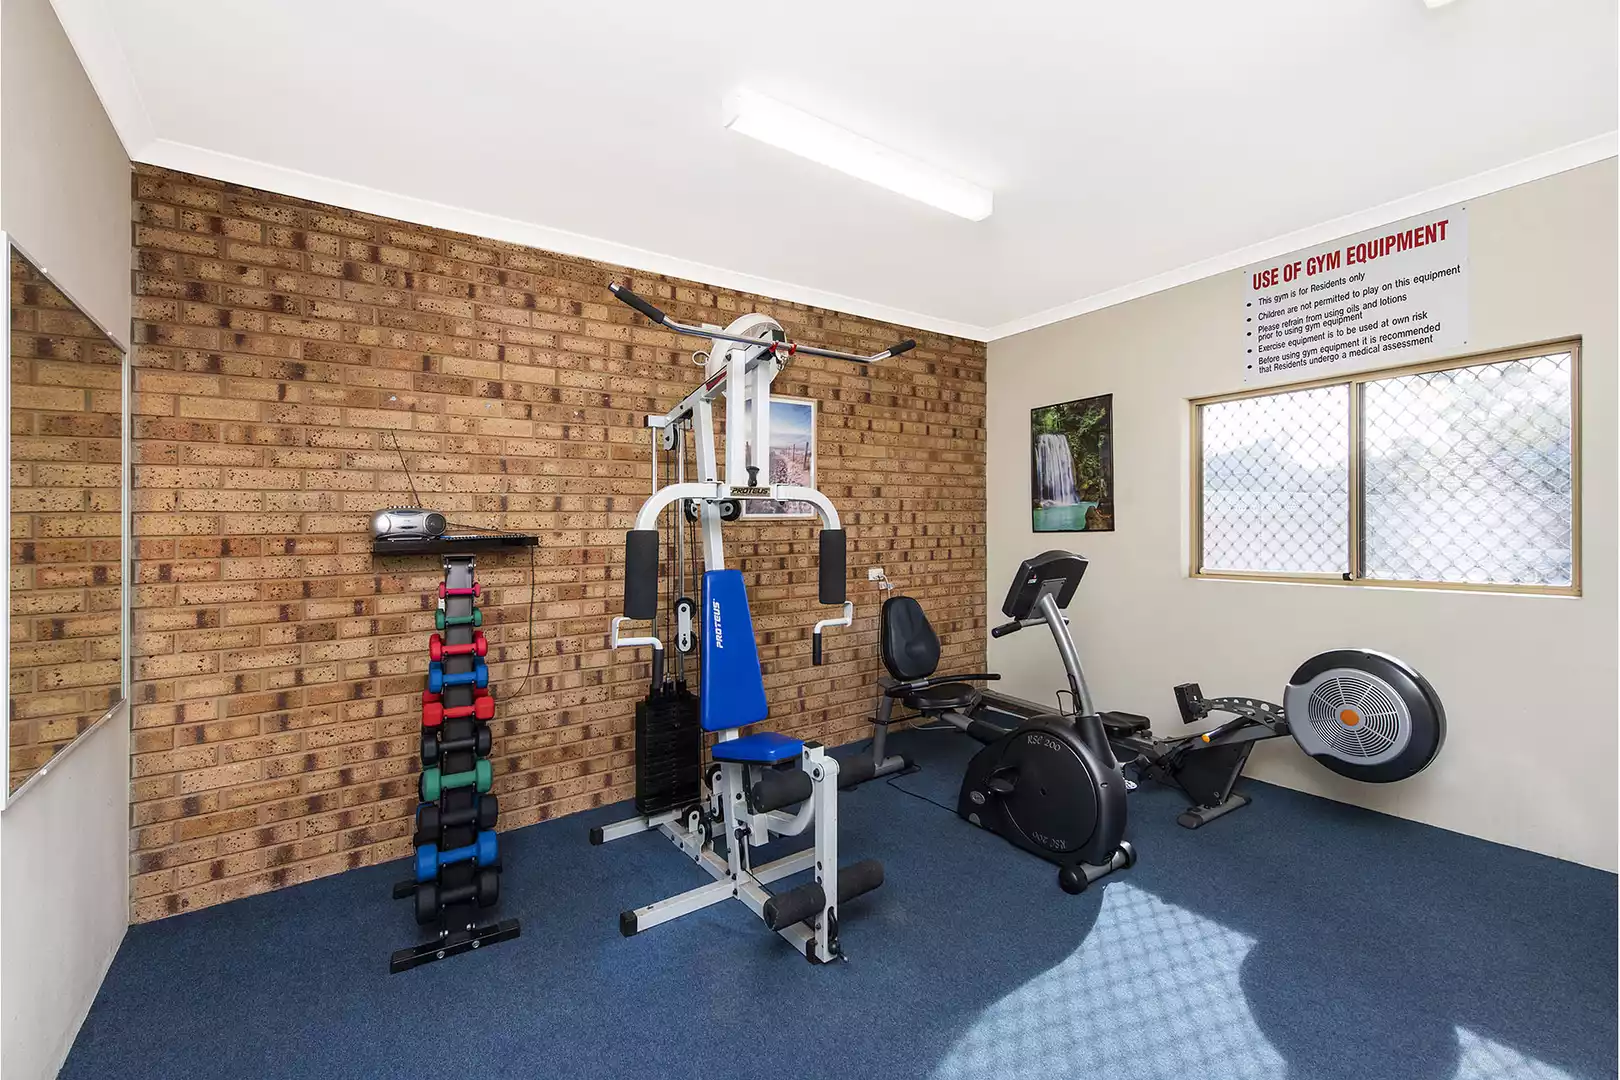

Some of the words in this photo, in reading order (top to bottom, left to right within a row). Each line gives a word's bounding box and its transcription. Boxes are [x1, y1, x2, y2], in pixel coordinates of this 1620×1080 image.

[1253, 268, 1278, 290] USE
[1284, 261, 1302, 282] OF
[1306, 250, 1340, 276] GYM
[1346, 220, 1448, 265] EQUIPMENT
[1258, 297, 1272, 306] This
[1274, 293, 1288, 303] gym
[1299, 288, 1308, 296] for
[1311, 275, 1346, 293] Residents
[1349, 272, 1365, 282] only
[1258, 309, 1285, 320] Children
[1287, 305, 1298, 314] are
[1301, 302, 1312, 310] not
[1314, 291, 1350, 309] permitted
[1353, 289, 1360, 298] to
[1362, 286, 1379, 298] play
[1382, 283, 1392, 291] on
[1395, 278, 1410, 288] this
[1413, 264, 1461, 284] equipment
[1258, 323, 1279, 333] Please
[1282, 317, 1304, 328] refrain
[1306, 312, 1322, 322] from
[1324, 308, 1344, 319] using
[1347, 304, 1359, 313] oils
[1362, 300, 1377, 310] and
[1380, 293, 1407, 306] lotions
[1258, 332, 1273, 342] prior
[1285, 326, 1302, 336] using
[1305, 322, 1320, 332] gym
[1323, 311, 1363, 328] equipment
[1258, 341, 1285, 352] Exercise
[1288, 332, 1325, 347] equipment
[1336, 329, 1344, 337] to
[1347, 325, 1356, 335] be
[1359, 321, 1378, 332] used
[1381, 319, 1389, 327] at
[1392, 316, 1410, 325] own
[1412, 311, 1428, 321] risk
[1259, 354, 1279, 365] Before
[1282, 350, 1300, 360] using
[1302, 346, 1318, 357] gym
[1320, 339, 1360, 354] equipment
[1362, 337, 1367, 345] it
[1370, 335, 1376, 344] is
[1379, 322, 1441, 342] recommended
[1259, 364, 1272, 373] that
[1274, 357, 1307, 371] Residents
[1310, 353, 1339, 364] undergo
[1349, 344, 1380, 357] medical
[1383, 334, 1433, 351] assessment
[731, 487, 768, 495] PROTEUS
[713, 601, 723, 648] PROTEUS
[1044, 739, 1061, 751] 200
